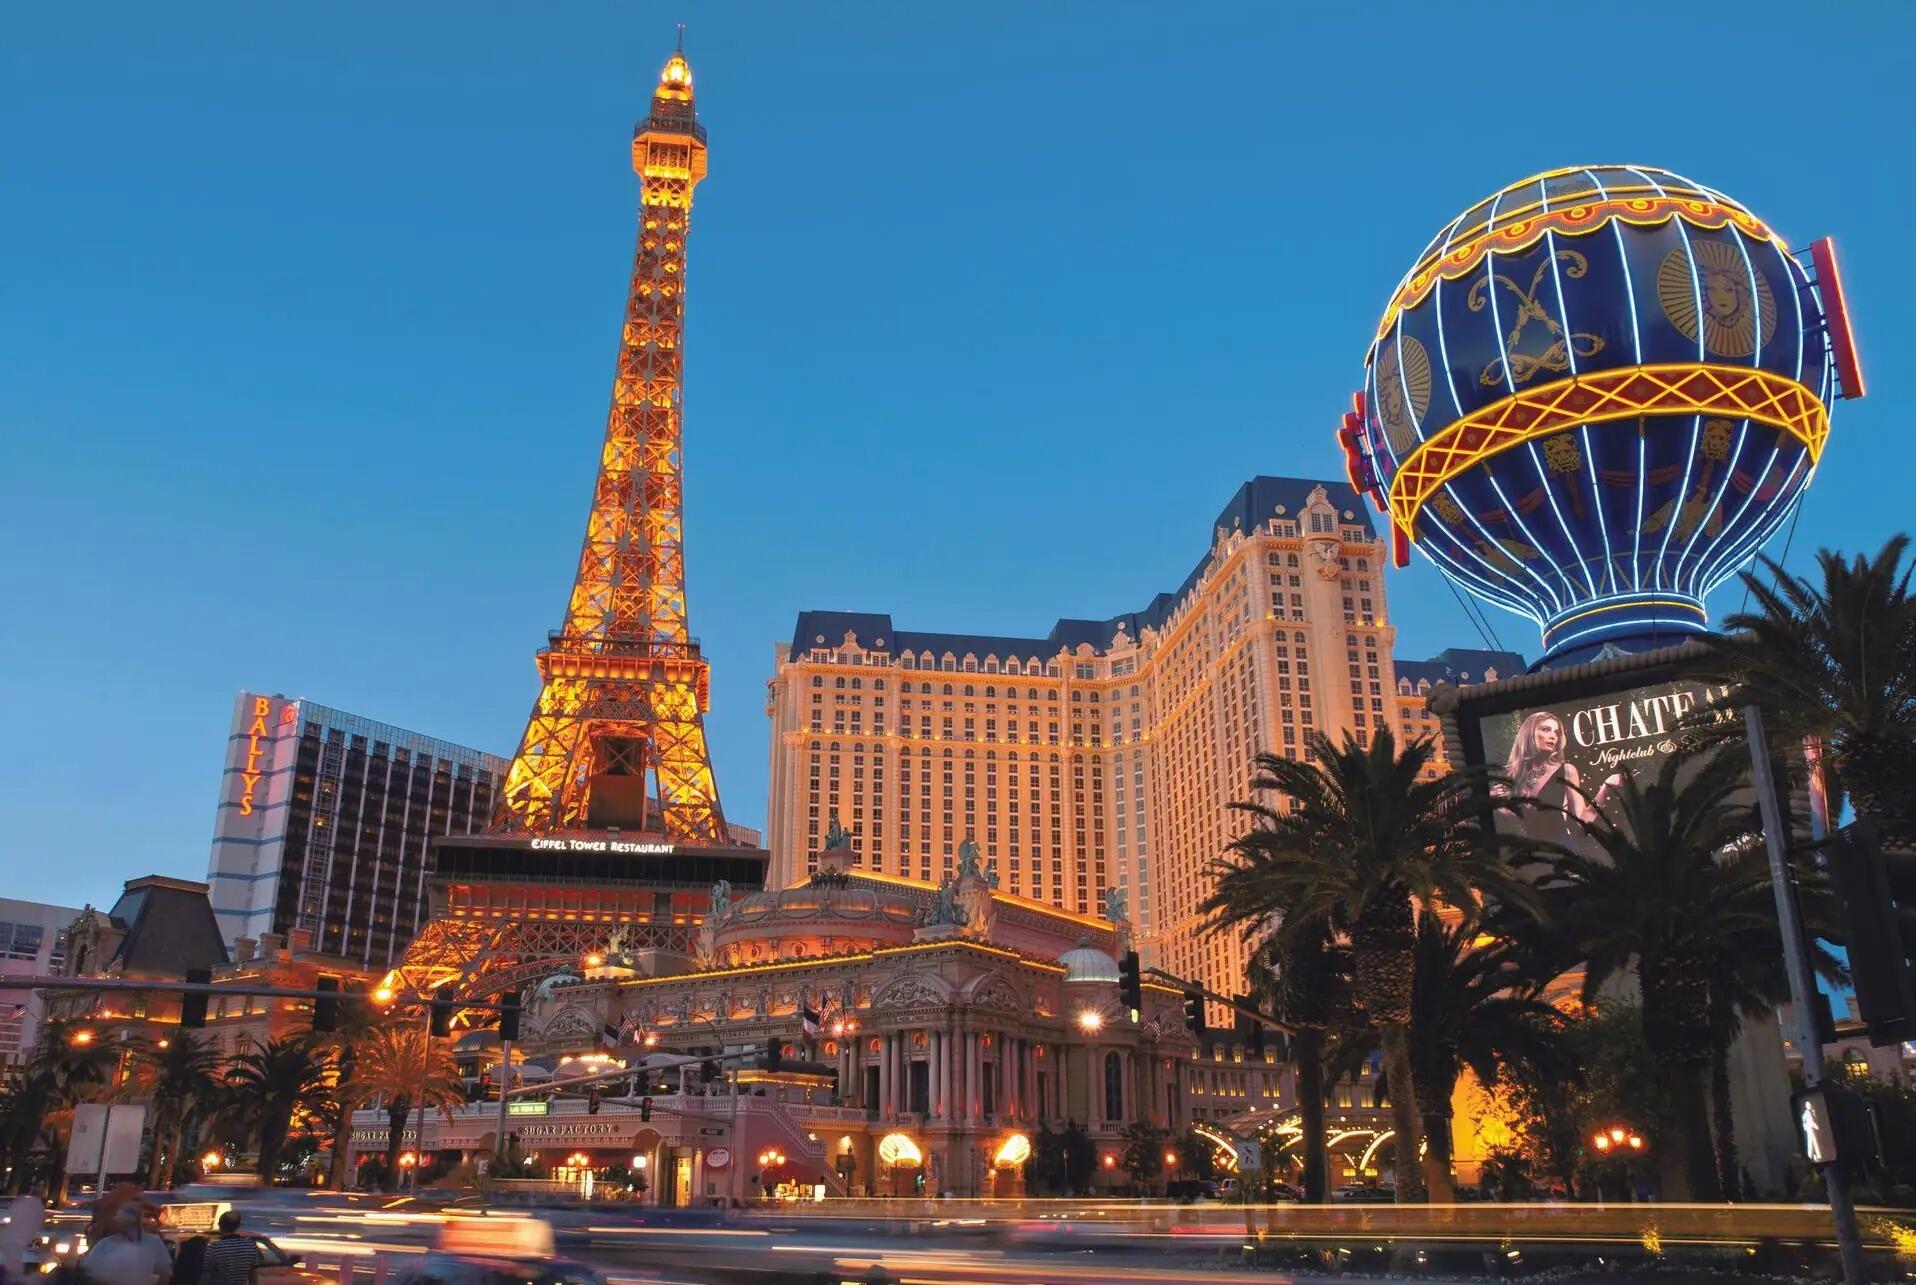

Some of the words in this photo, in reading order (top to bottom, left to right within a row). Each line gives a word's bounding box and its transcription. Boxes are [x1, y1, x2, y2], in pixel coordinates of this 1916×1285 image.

[1589, 745, 1654, 768] Nightclub
[1656, 738, 1677, 754] &
[531, 839, 566, 850] EIFFEL
[570, 840, 606, 851] TOWER
[610, 842, 674, 853] RESTAURANT
[523, 1125, 556, 1135] SUGAR
[561, 1124, 614, 1134] FACTORY
